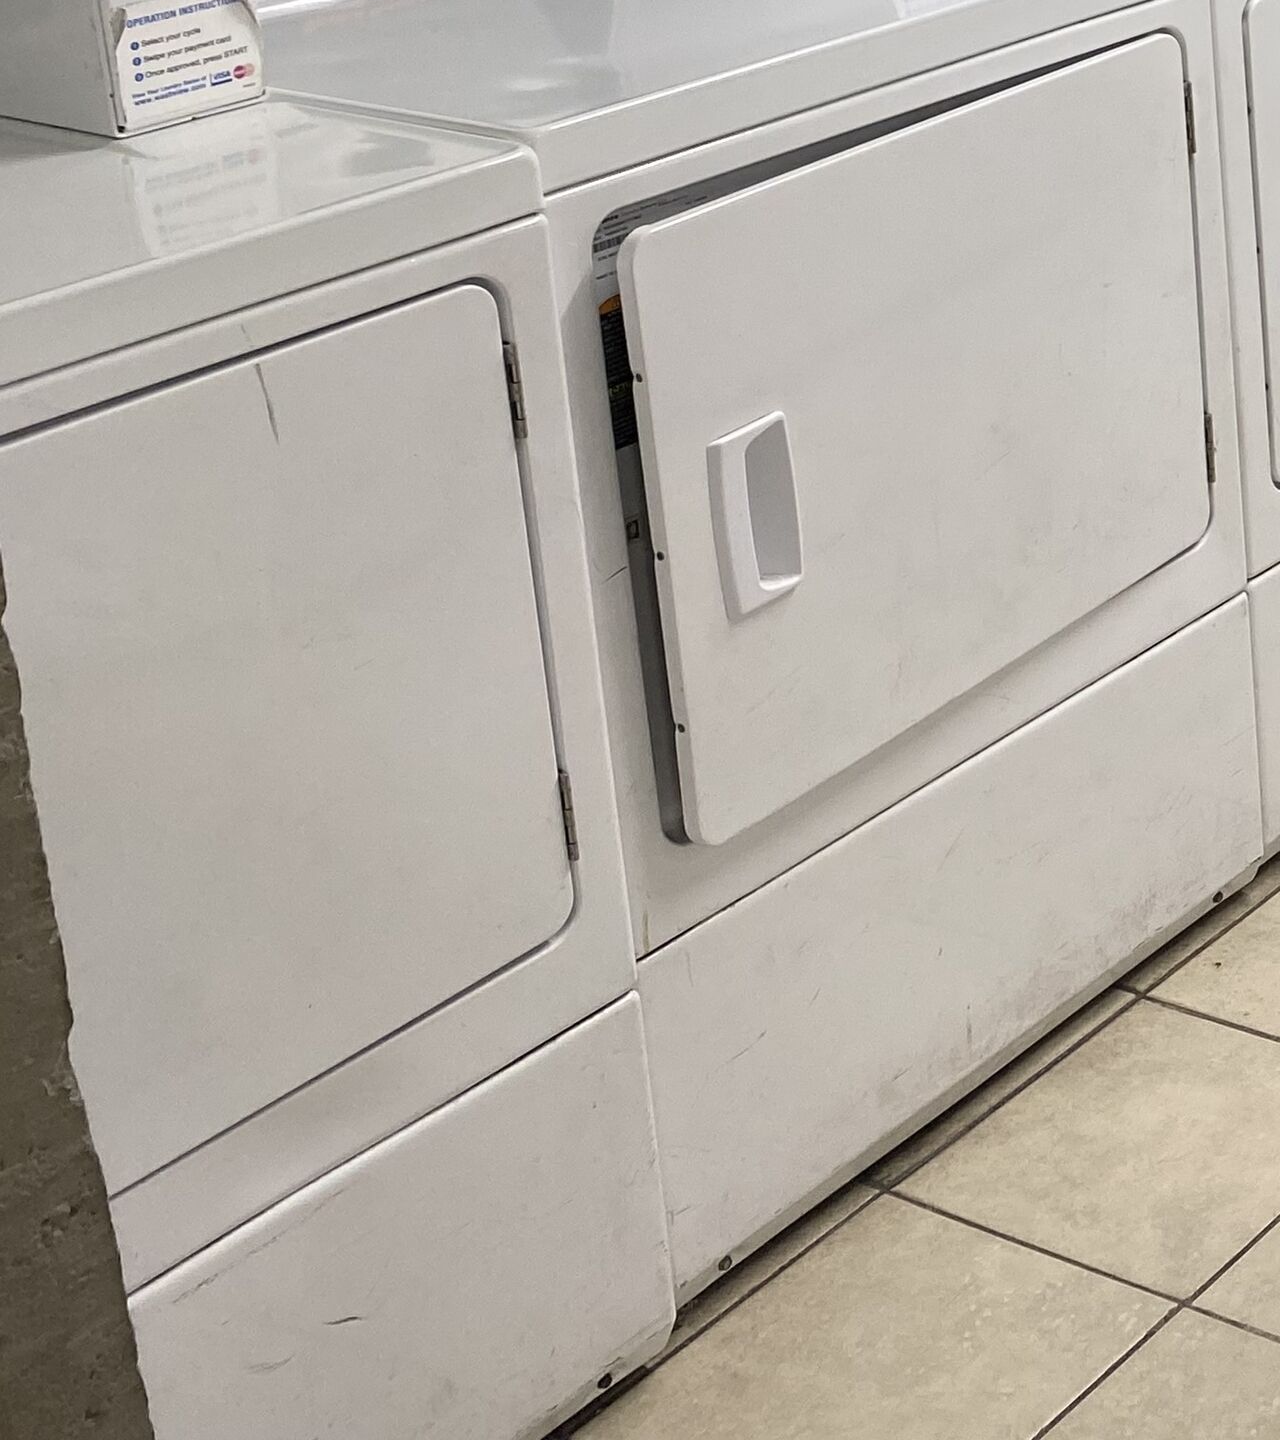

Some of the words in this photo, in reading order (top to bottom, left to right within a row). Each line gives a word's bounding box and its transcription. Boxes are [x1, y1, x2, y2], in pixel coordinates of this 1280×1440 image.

[126, 10, 177, 28] OPERATION
[141, 36, 165, 47] Select
[166, 32, 182, 43] your
[183, 27, 201, 38] cycle
[167, 48, 183, 59] your
[184, 40, 215, 54] payment
[216, 35, 232, 45] card
[145, 68, 165, 79] Once
[203, 54, 223, 65] press
[224, 46, 248, 58] START
